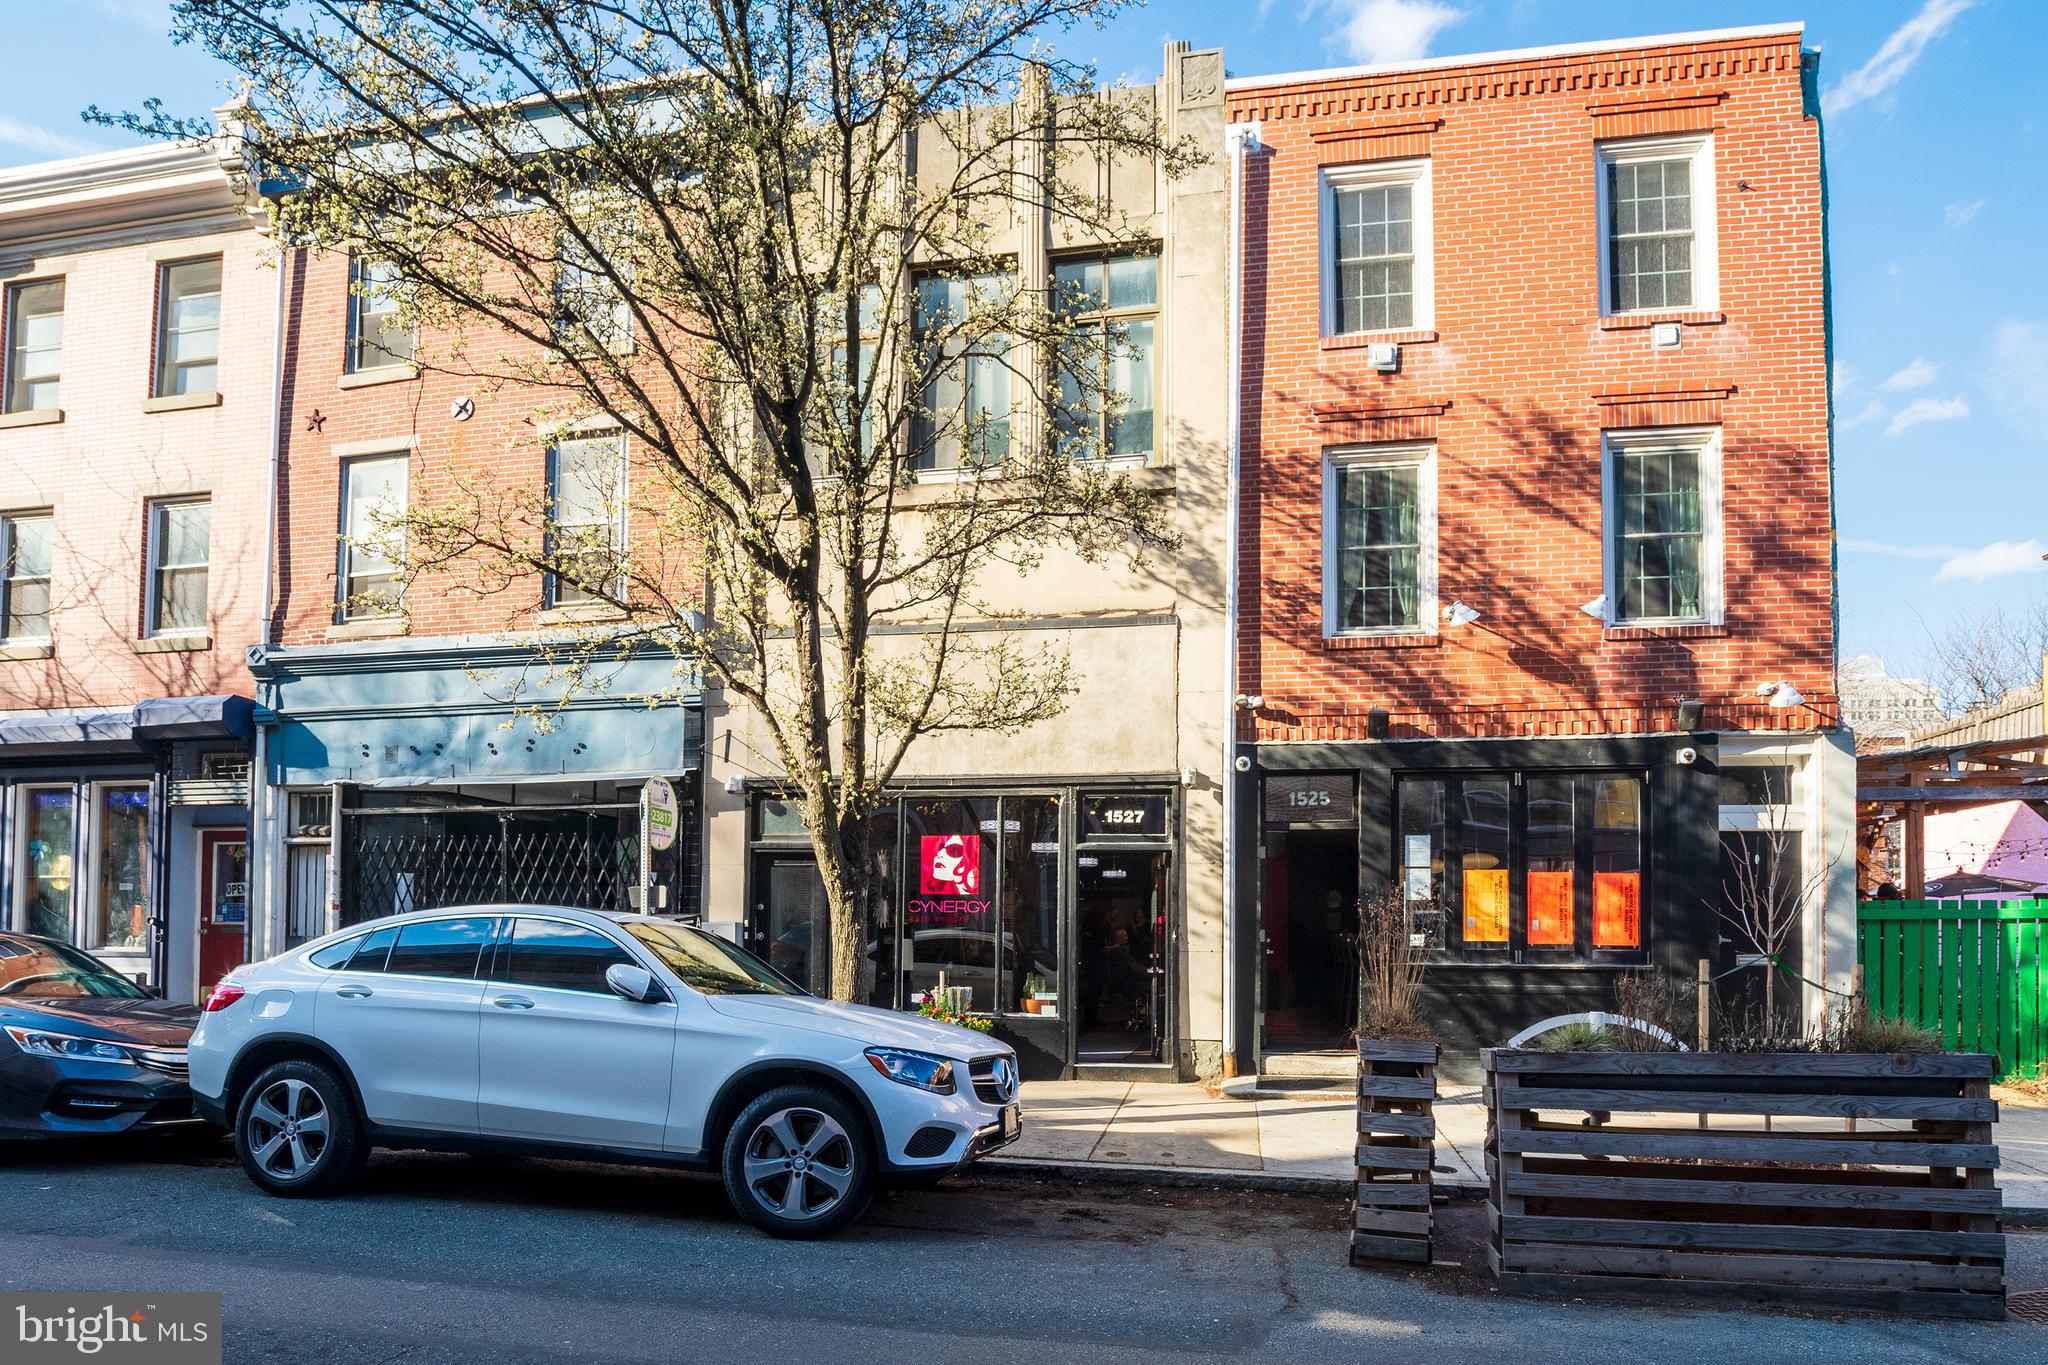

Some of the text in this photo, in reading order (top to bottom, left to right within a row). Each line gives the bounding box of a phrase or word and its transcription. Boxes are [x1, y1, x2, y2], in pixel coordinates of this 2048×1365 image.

[1289, 791, 1330, 806] 1525
[651, 809, 672, 825] 23817
[1105, 810, 1145, 823] 1527
[909, 900, 991, 913] CYNERGY
